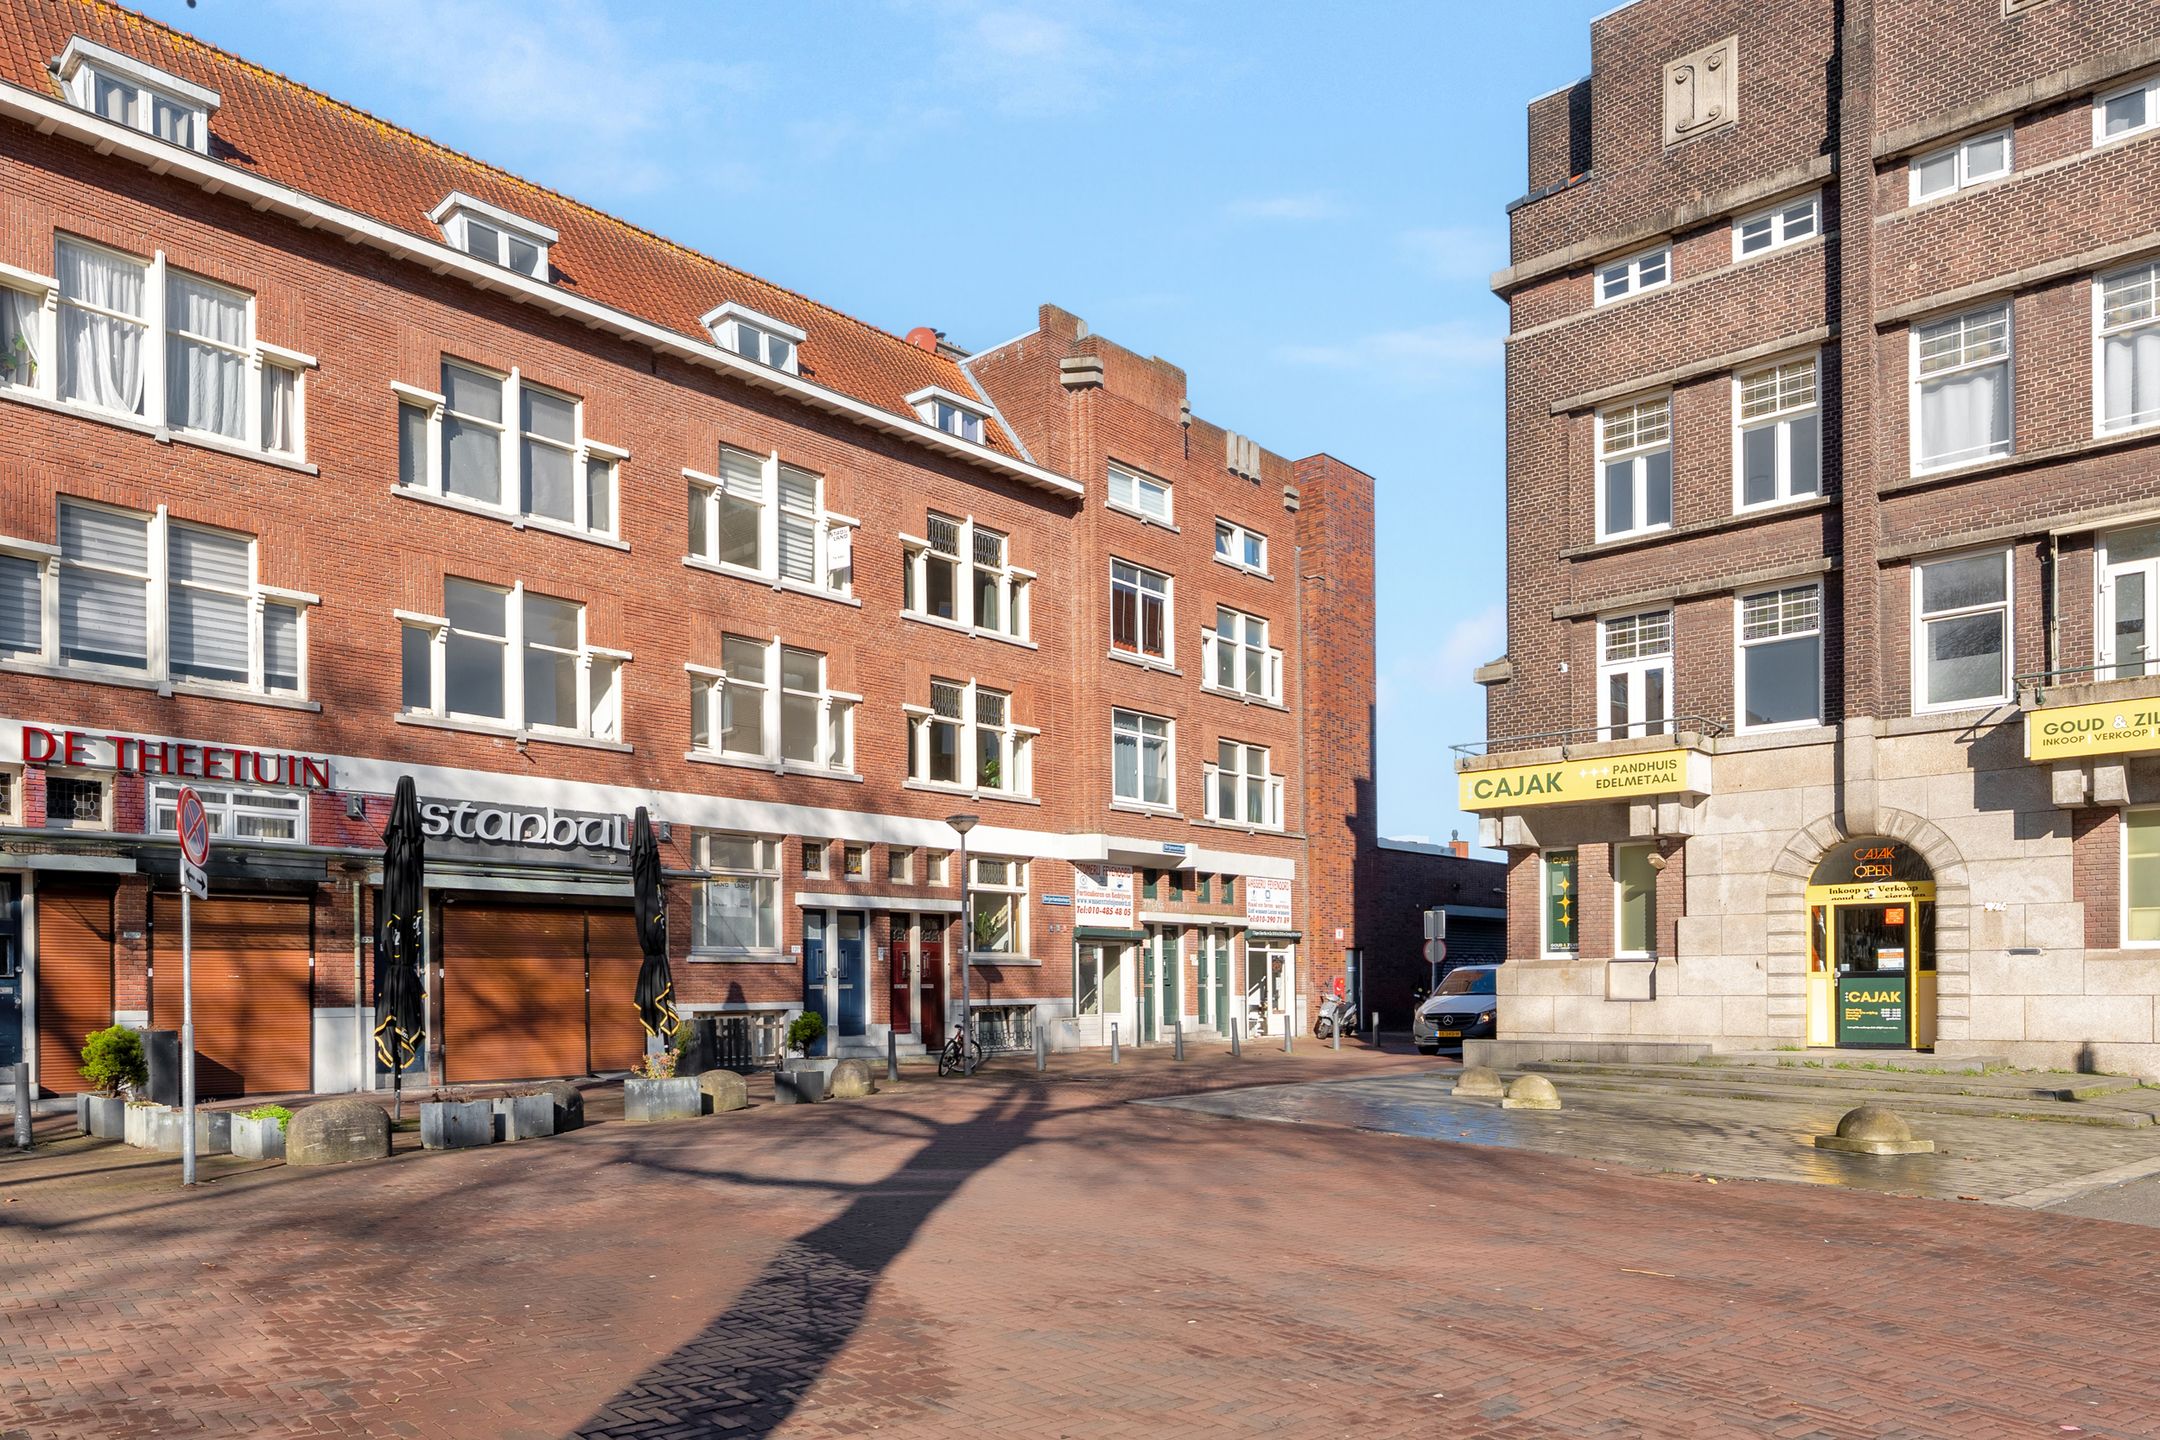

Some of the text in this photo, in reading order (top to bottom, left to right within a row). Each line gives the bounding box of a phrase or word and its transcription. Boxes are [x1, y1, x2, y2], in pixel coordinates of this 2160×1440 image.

[2043, 711, 2160, 735] GOUD & ZIL
[2042, 735, 2085, 746] INKOOP
[2094, 729, 2148, 741] VERKOOP
[22, 726, 329, 789] DE THEETUIN
[1473, 759, 1677, 799] CAJAK PANDHUIS
[1596, 773, 1678, 789] EDELMETAAL
[1552, 856, 1577, 864] CAJA
[1853, 847, 1895, 861] CAJAK
[1854, 864, 1892, 877] OPEN
[1829, 887, 1861, 895] Inkoop
[1076, 905, 1131, 916] Tel:010-485 48 05
[1848, 991, 1901, 1002] CAJAK
